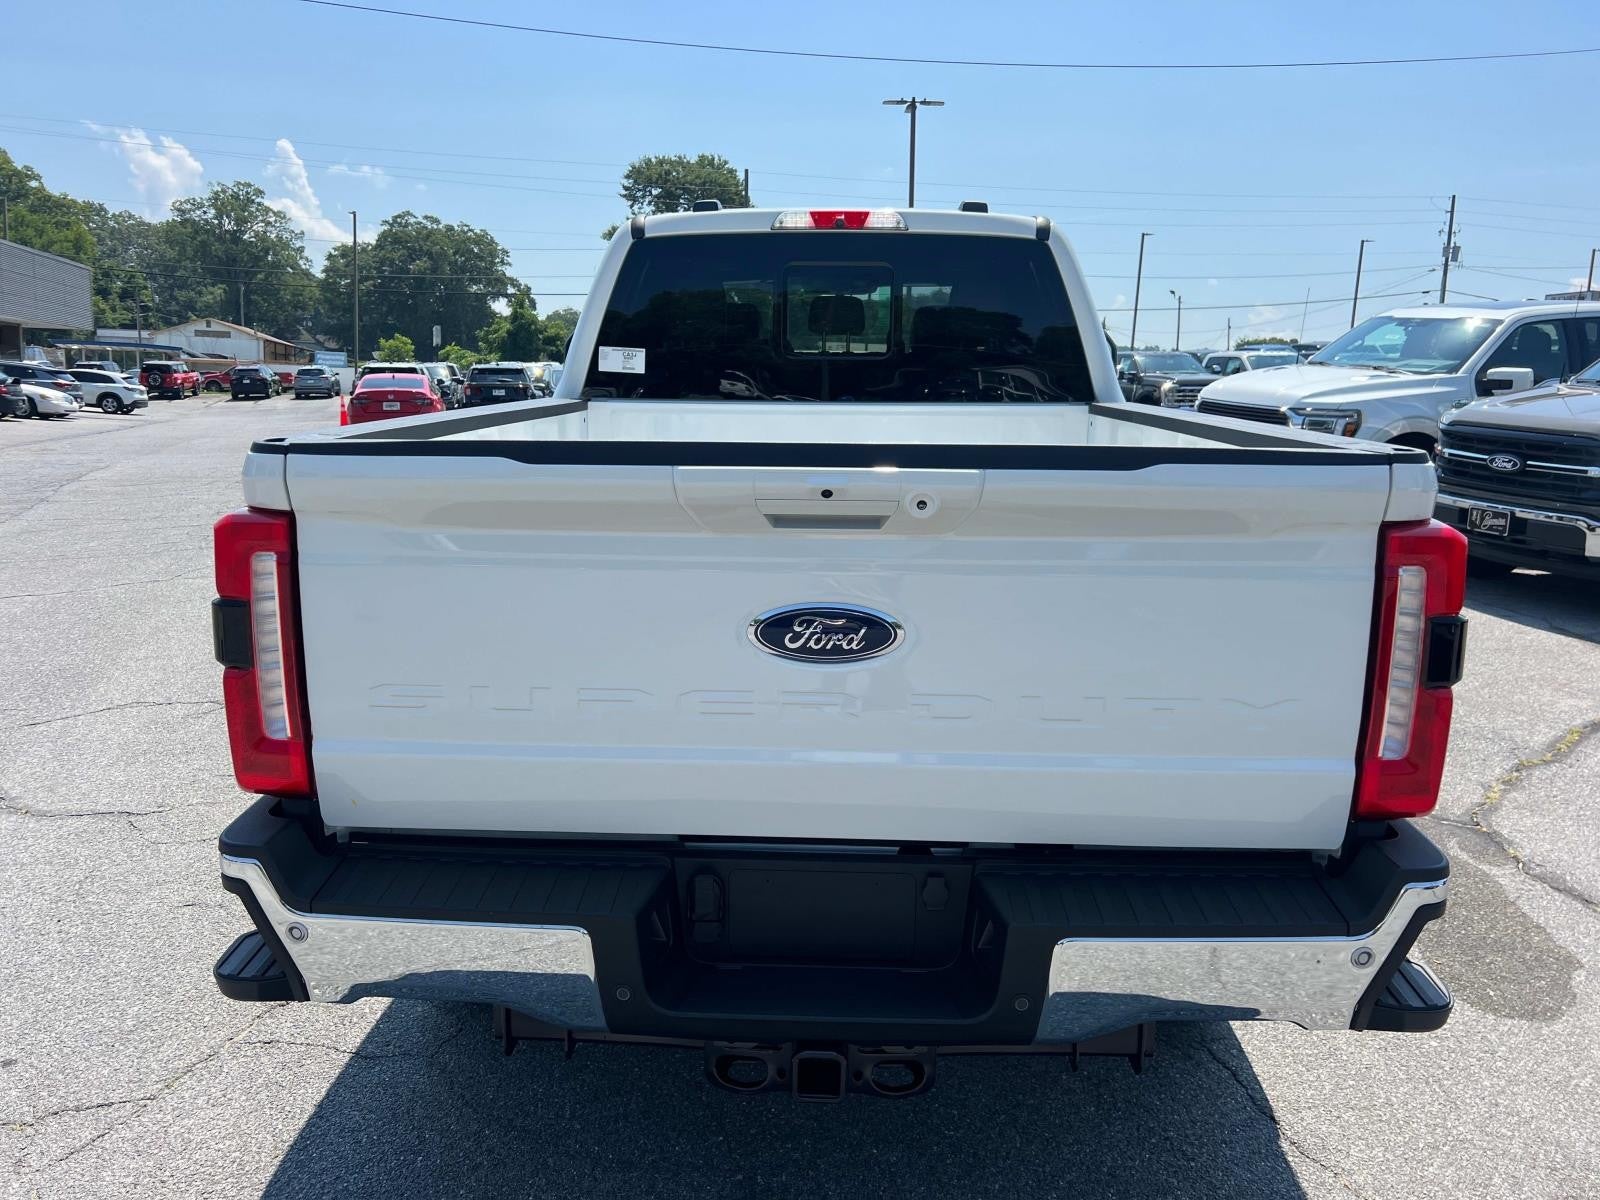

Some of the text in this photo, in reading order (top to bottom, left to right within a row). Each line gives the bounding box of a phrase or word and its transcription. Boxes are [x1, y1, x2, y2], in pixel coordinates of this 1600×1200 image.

[1492, 456, 1514, 469] Ford
[784, 615, 868, 650] Ford
[367, 683, 1304, 730] SUPER DUTY
